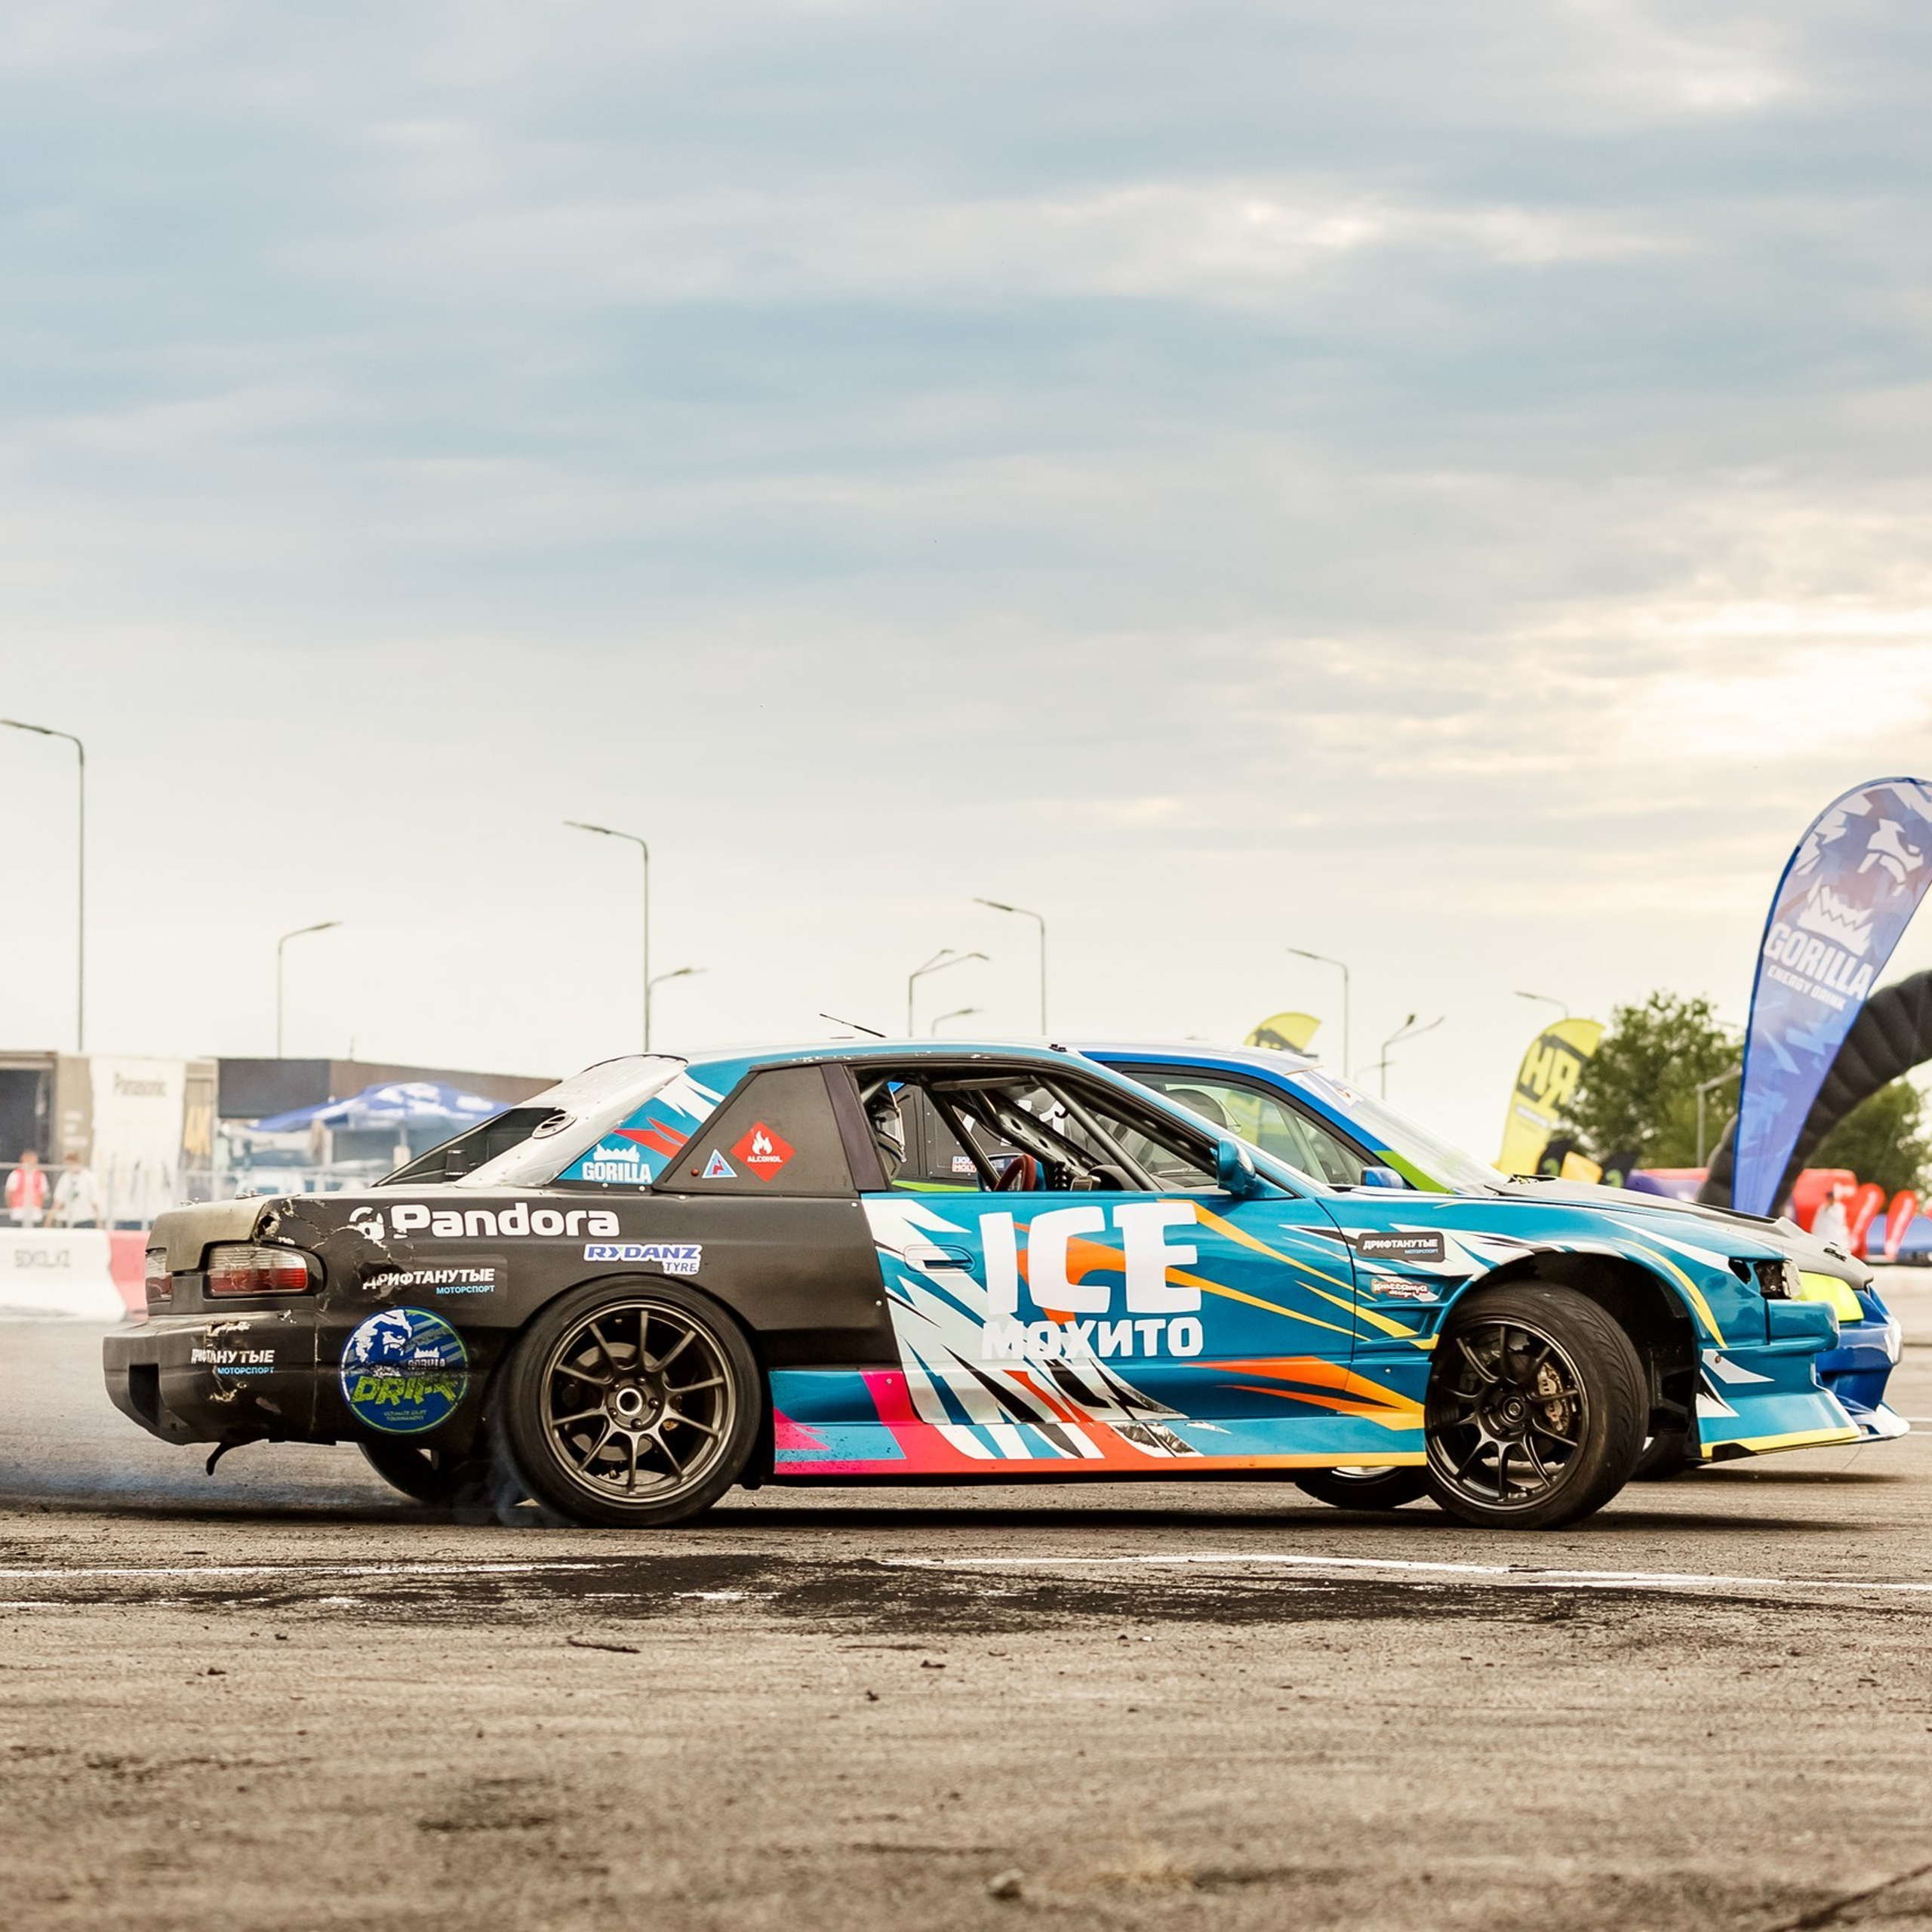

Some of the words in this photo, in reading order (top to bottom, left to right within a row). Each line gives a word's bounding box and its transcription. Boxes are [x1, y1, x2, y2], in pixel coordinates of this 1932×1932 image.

[1763, 922, 1874, 1001] GORILLA
[1767, 964, 1813, 995] ENERGY
[1810, 985, 1847, 1011] DRINK
[582, 1161, 653, 1184] GORILLA
[390, 1202, 620, 1239] Pandora
[587, 1246, 698, 1259] RYDANZ
[1363, 1238, 1438, 1250] ДРИФТАНУТЫЕ
[665, 1262, 697, 1272] TYRE
[979, 1202, 1201, 1314] ICE
[362, 1269, 495, 1290] ДРИФТАНУТЫЕ
[436, 1284, 495, 1295] МОТОРСПОРТ
[981, 1317, 1204, 1359] МОХИТО
